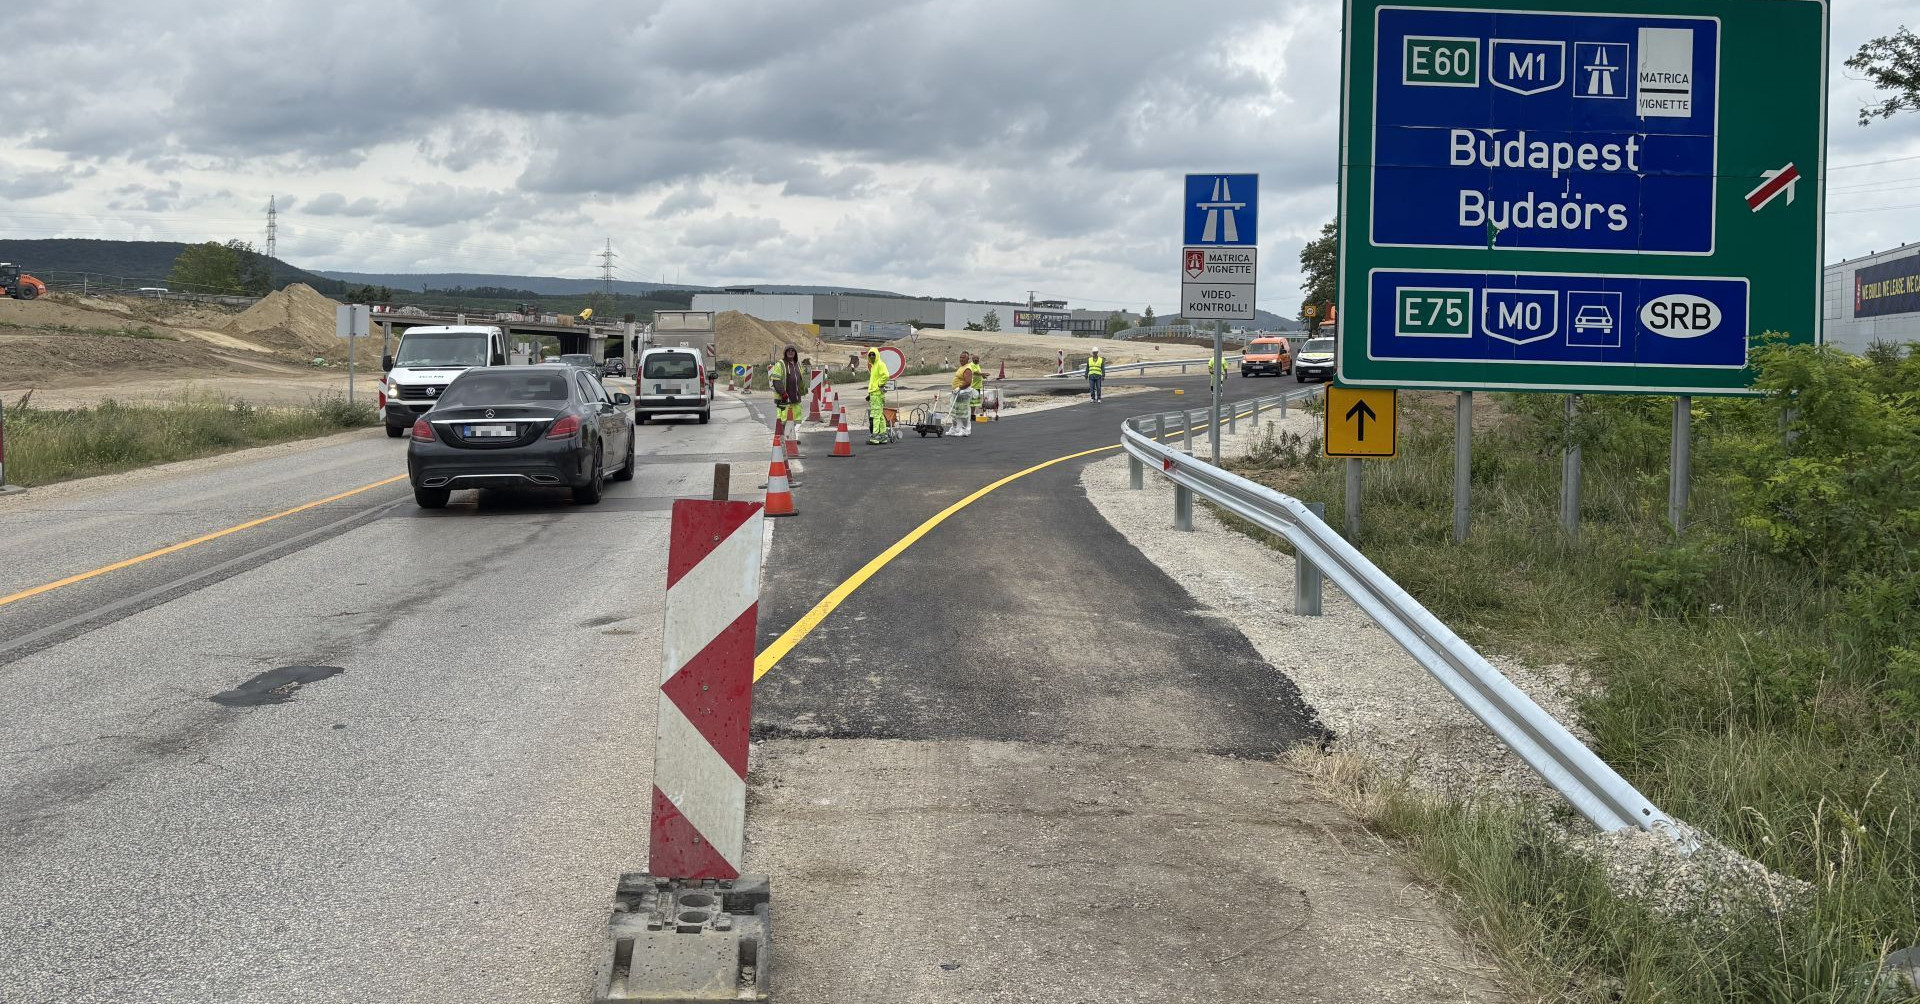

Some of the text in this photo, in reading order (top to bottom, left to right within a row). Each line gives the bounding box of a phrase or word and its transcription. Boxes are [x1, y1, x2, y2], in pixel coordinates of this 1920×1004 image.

[1412, 45, 1470, 76] E60
[1508, 52, 1546, 81] M1
[1639, 72, 1689, 84] MATRICA
[1639, 98, 1689, 110] VIGNETTE
[1450, 129, 1639, 179] Budapest
[1459, 189, 1628, 231] Budaörs
[1206, 265, 1251, 273] VIGNETTE
[1209, 254, 1250, 262] MATRICA
[1201, 290, 1236, 299] VIDEO-
[1882, 281, 1890, 296] WE
[1906, 276, 1914, 293] WE
[1189, 302, 1248, 312] KONTROLL!
[1405, 297, 1463, 327] E75
[1498, 301, 1542, 331] M0
[1649, 301, 1711, 330] SRB
